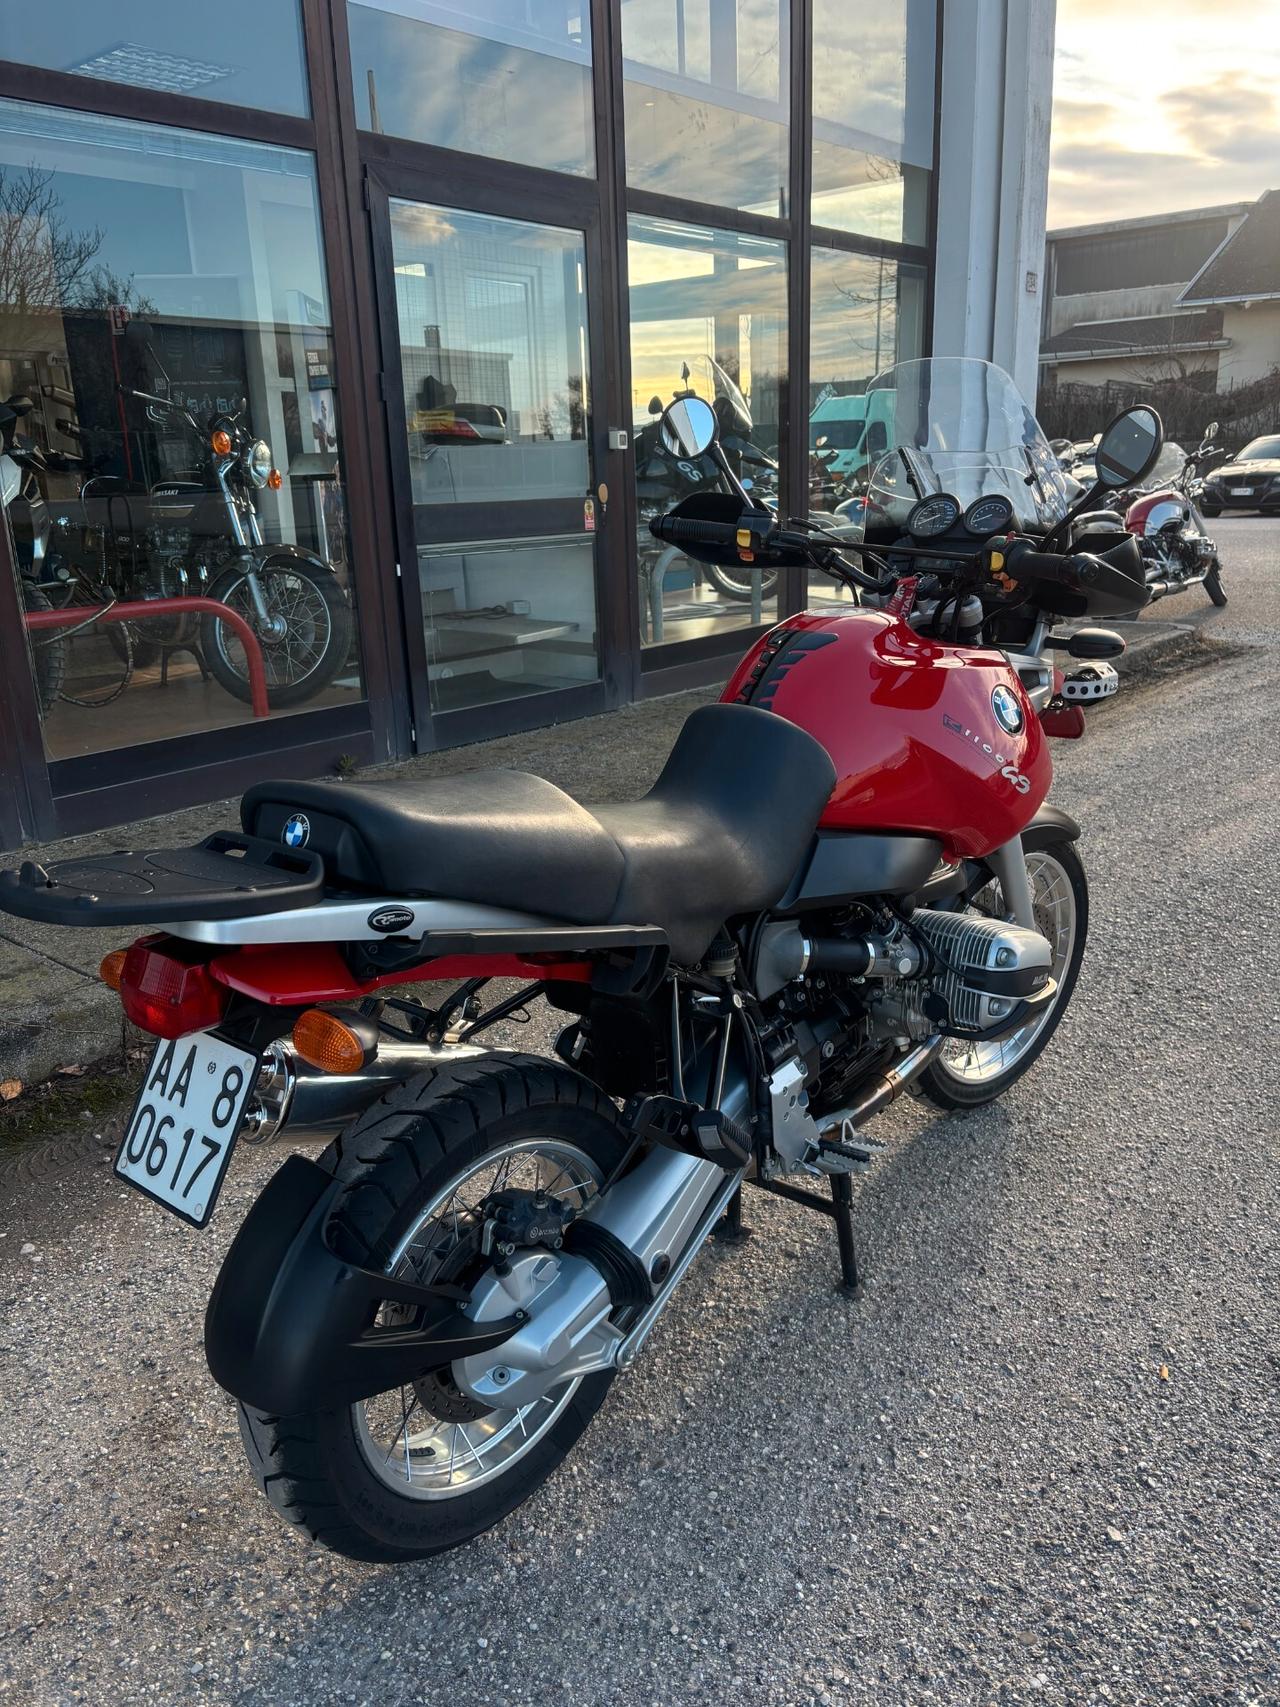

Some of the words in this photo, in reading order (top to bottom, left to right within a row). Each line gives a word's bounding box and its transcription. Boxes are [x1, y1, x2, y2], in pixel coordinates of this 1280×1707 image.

[677, 461, 703, 481] GS
[964, 729, 1004, 763] 1100
[1001, 766, 1031, 794] GS
[149, 1040, 198, 1108] AA
[211, 1065, 244, 1128] 8
[126, 1104, 222, 1199] 0617
